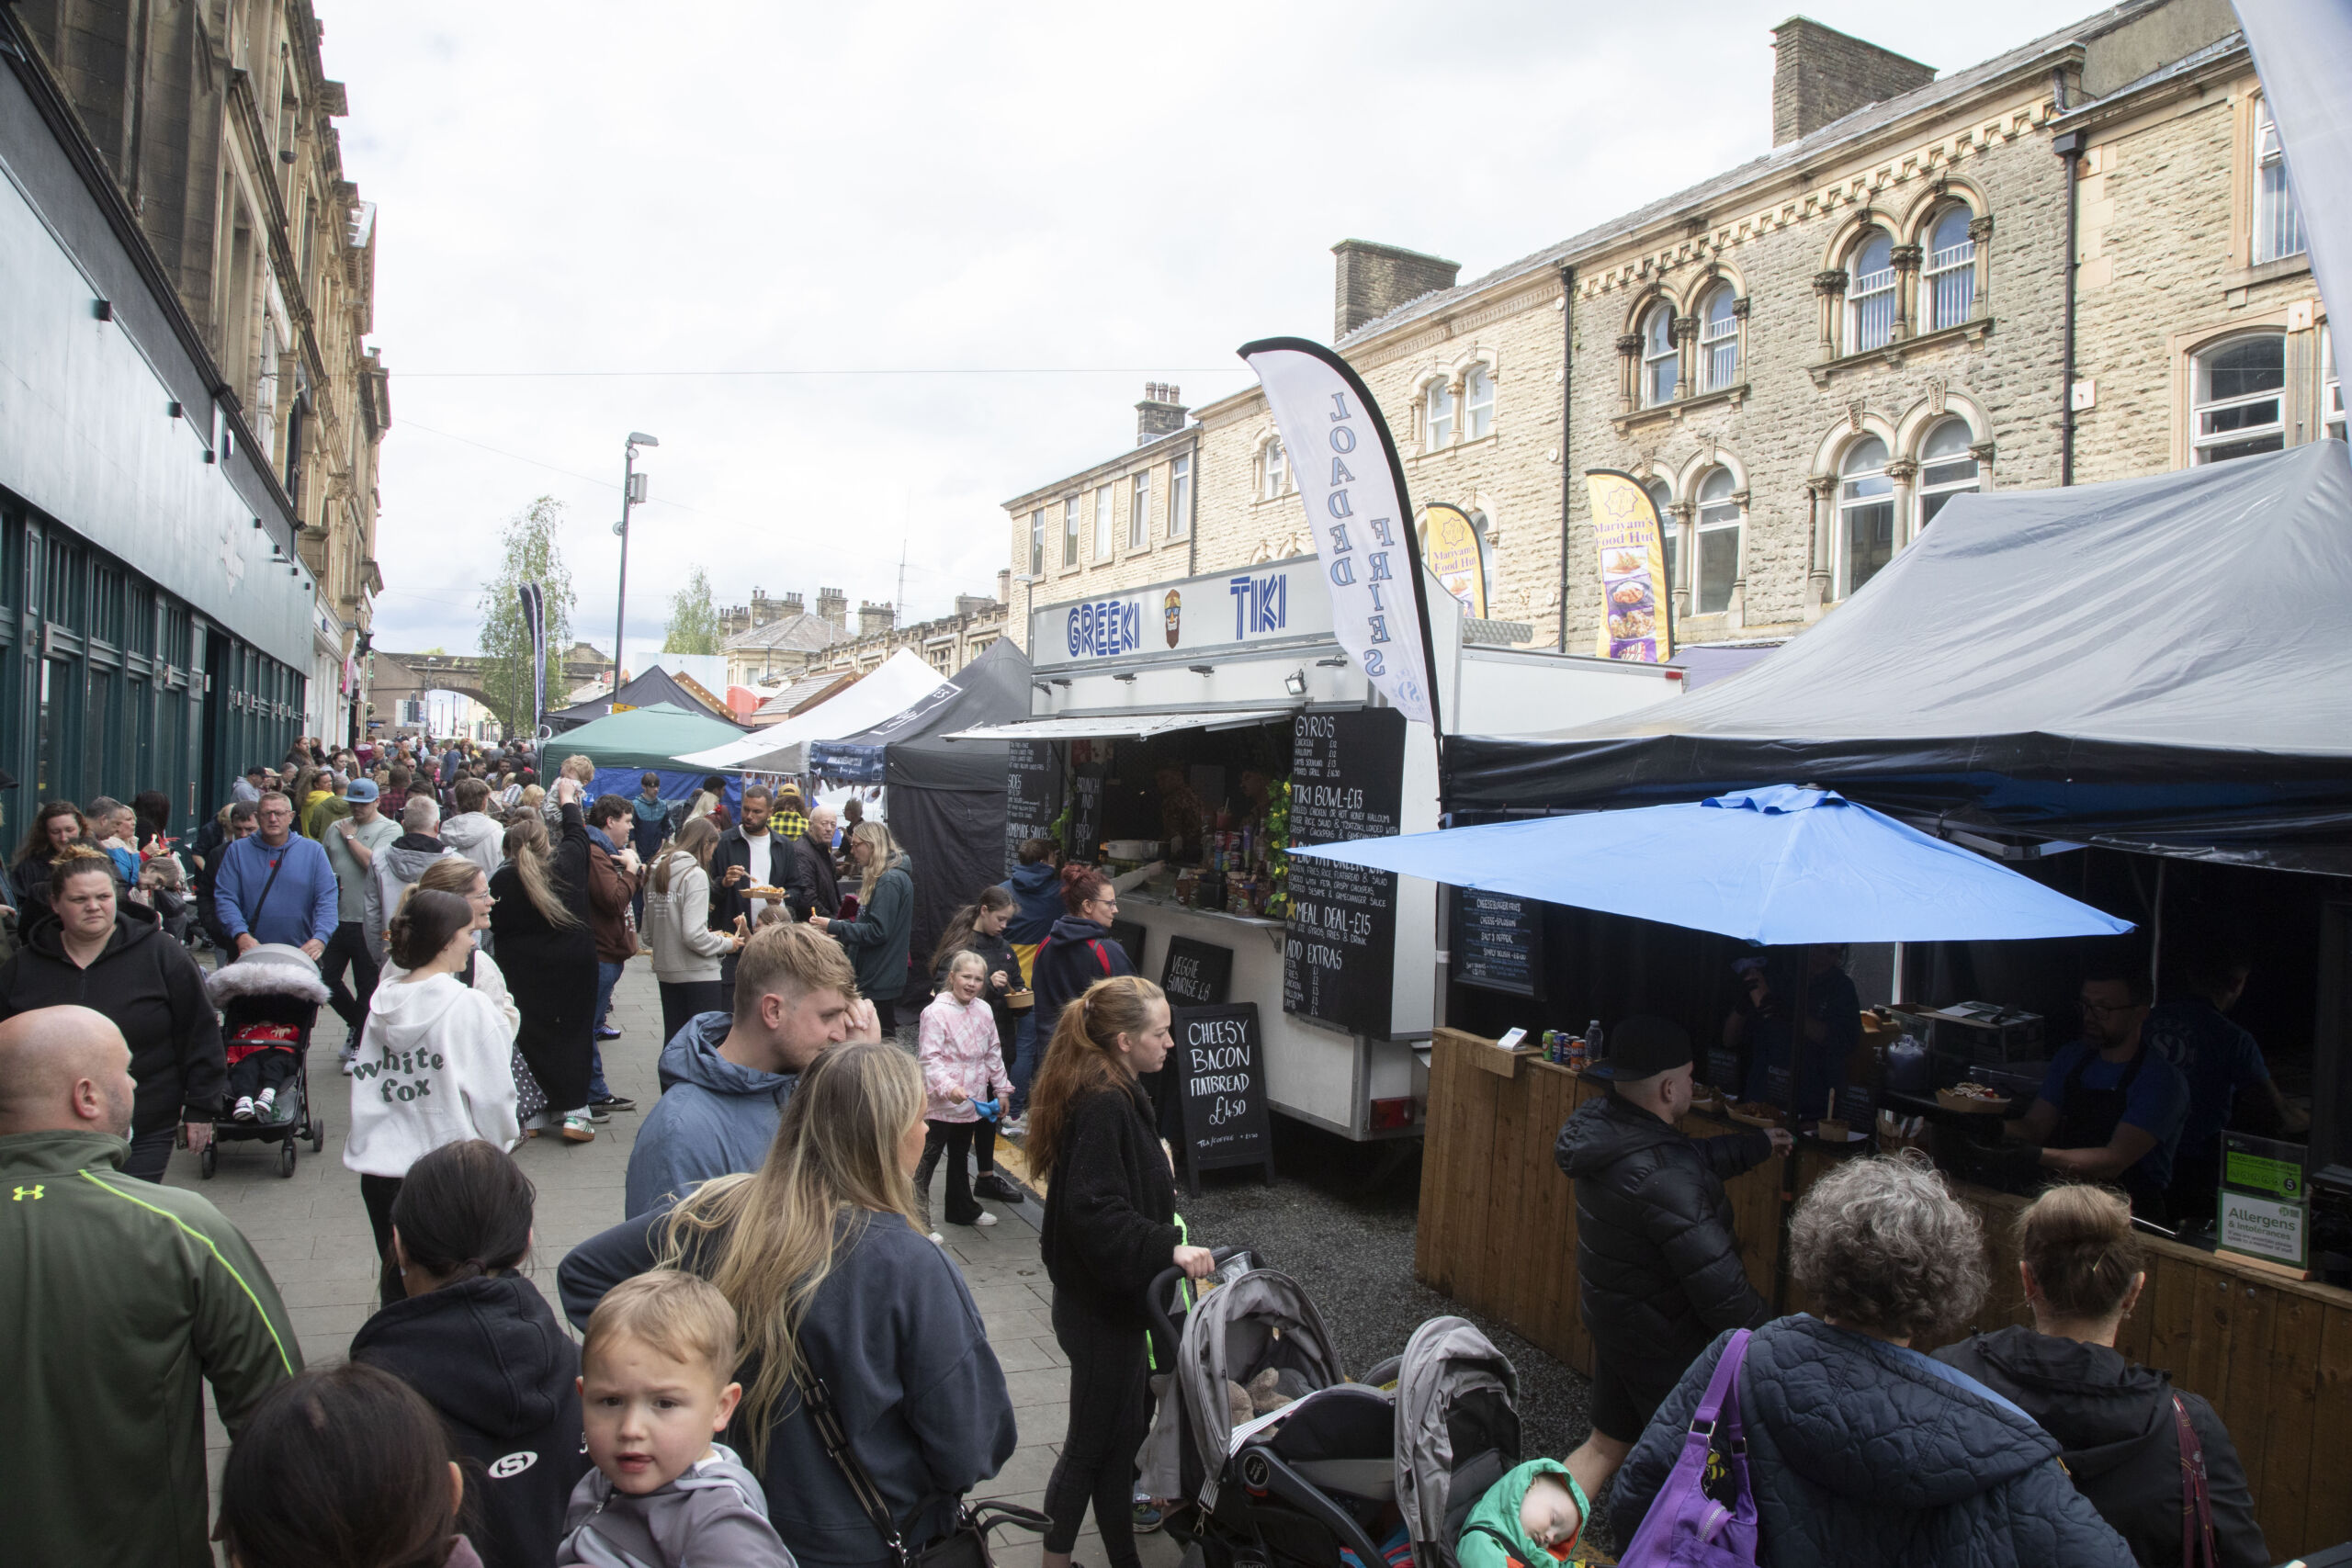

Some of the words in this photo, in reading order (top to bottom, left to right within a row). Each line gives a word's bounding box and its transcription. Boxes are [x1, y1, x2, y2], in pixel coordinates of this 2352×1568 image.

[1596, 533, 1624, 548] Food
[1630, 531, 1653, 543] Hut
[1434, 560, 1458, 573] Food
[1461, 557, 1476, 568] Hut
[1068, 601, 1140, 657] GREEKI
[1230, 574, 1286, 640] TIKI
[1295, 716, 1334, 738] GYROS
[1081, 794, 1093, 809] AND
[1293, 784, 1311, 805] TIKI
[1291, 816, 1303, 824] OVER
[1317, 818, 1331, 828] SALAD
[1334, 819, 1340, 829] &
[1366, 825, 1383, 833] LOADED
[1309, 807, 1327, 818] CHICKEN
[1329, 809, 1336, 818] OR
[1339, 810, 1348, 818] HOT
[1351, 812, 1365, 821] HONEY
[1367, 813, 1390, 824] HALLOUMI
[1290, 824, 1305, 834] CRISPY
[1339, 829, 1343, 840] &
[1288, 873, 1304, 882] LOADED
[1333, 882, 1349, 890] CRISPY
[1334, 871, 1360, 881] FLATBREAD
[1363, 873, 1368, 883] &
[1372, 876, 1388, 886] SALAD
[1288, 882, 1305, 892] TOASTED
[1308, 886, 1325, 897] SESAME
[1329, 890, 1332, 898] &
[1335, 892, 1367, 904] GAMECHANGER
[1370, 899, 1386, 908] SAUCE
[1296, 901, 1318, 925] MEAL
[1509, 902, 1521, 912] FRIES
[1286, 919, 1295, 930] ANY
[1327, 931, 1340, 941] FRIES
[1343, 932, 1348, 942] &
[1351, 934, 1367, 945] DRINK
[1481, 931, 1490, 941] SALT
[1496, 933, 1513, 944] PEPPER
[1286, 939, 1303, 960] ADD
[1307, 943, 1342, 970] EXTRAS
[1286, 958, 1297, 969] FETA
[1171, 954, 1200, 980] VEGGIE
[1285, 969, 1299, 979] FRIES
[1167, 974, 1198, 998] SUNRISE
[1285, 977, 1301, 990] CHICKEN
[1188, 1020, 1249, 1046] CHEESY
[353, 1044, 444, 1081] white
[1190, 1045, 1250, 1073] BACON
[380, 1077, 431, 1103] fox
[1191, 1073, 1250, 1098] FLATBREAD
[2228, 1207, 2295, 1231] Allergens
[2237, 1222, 2290, 1240] Intolerances
